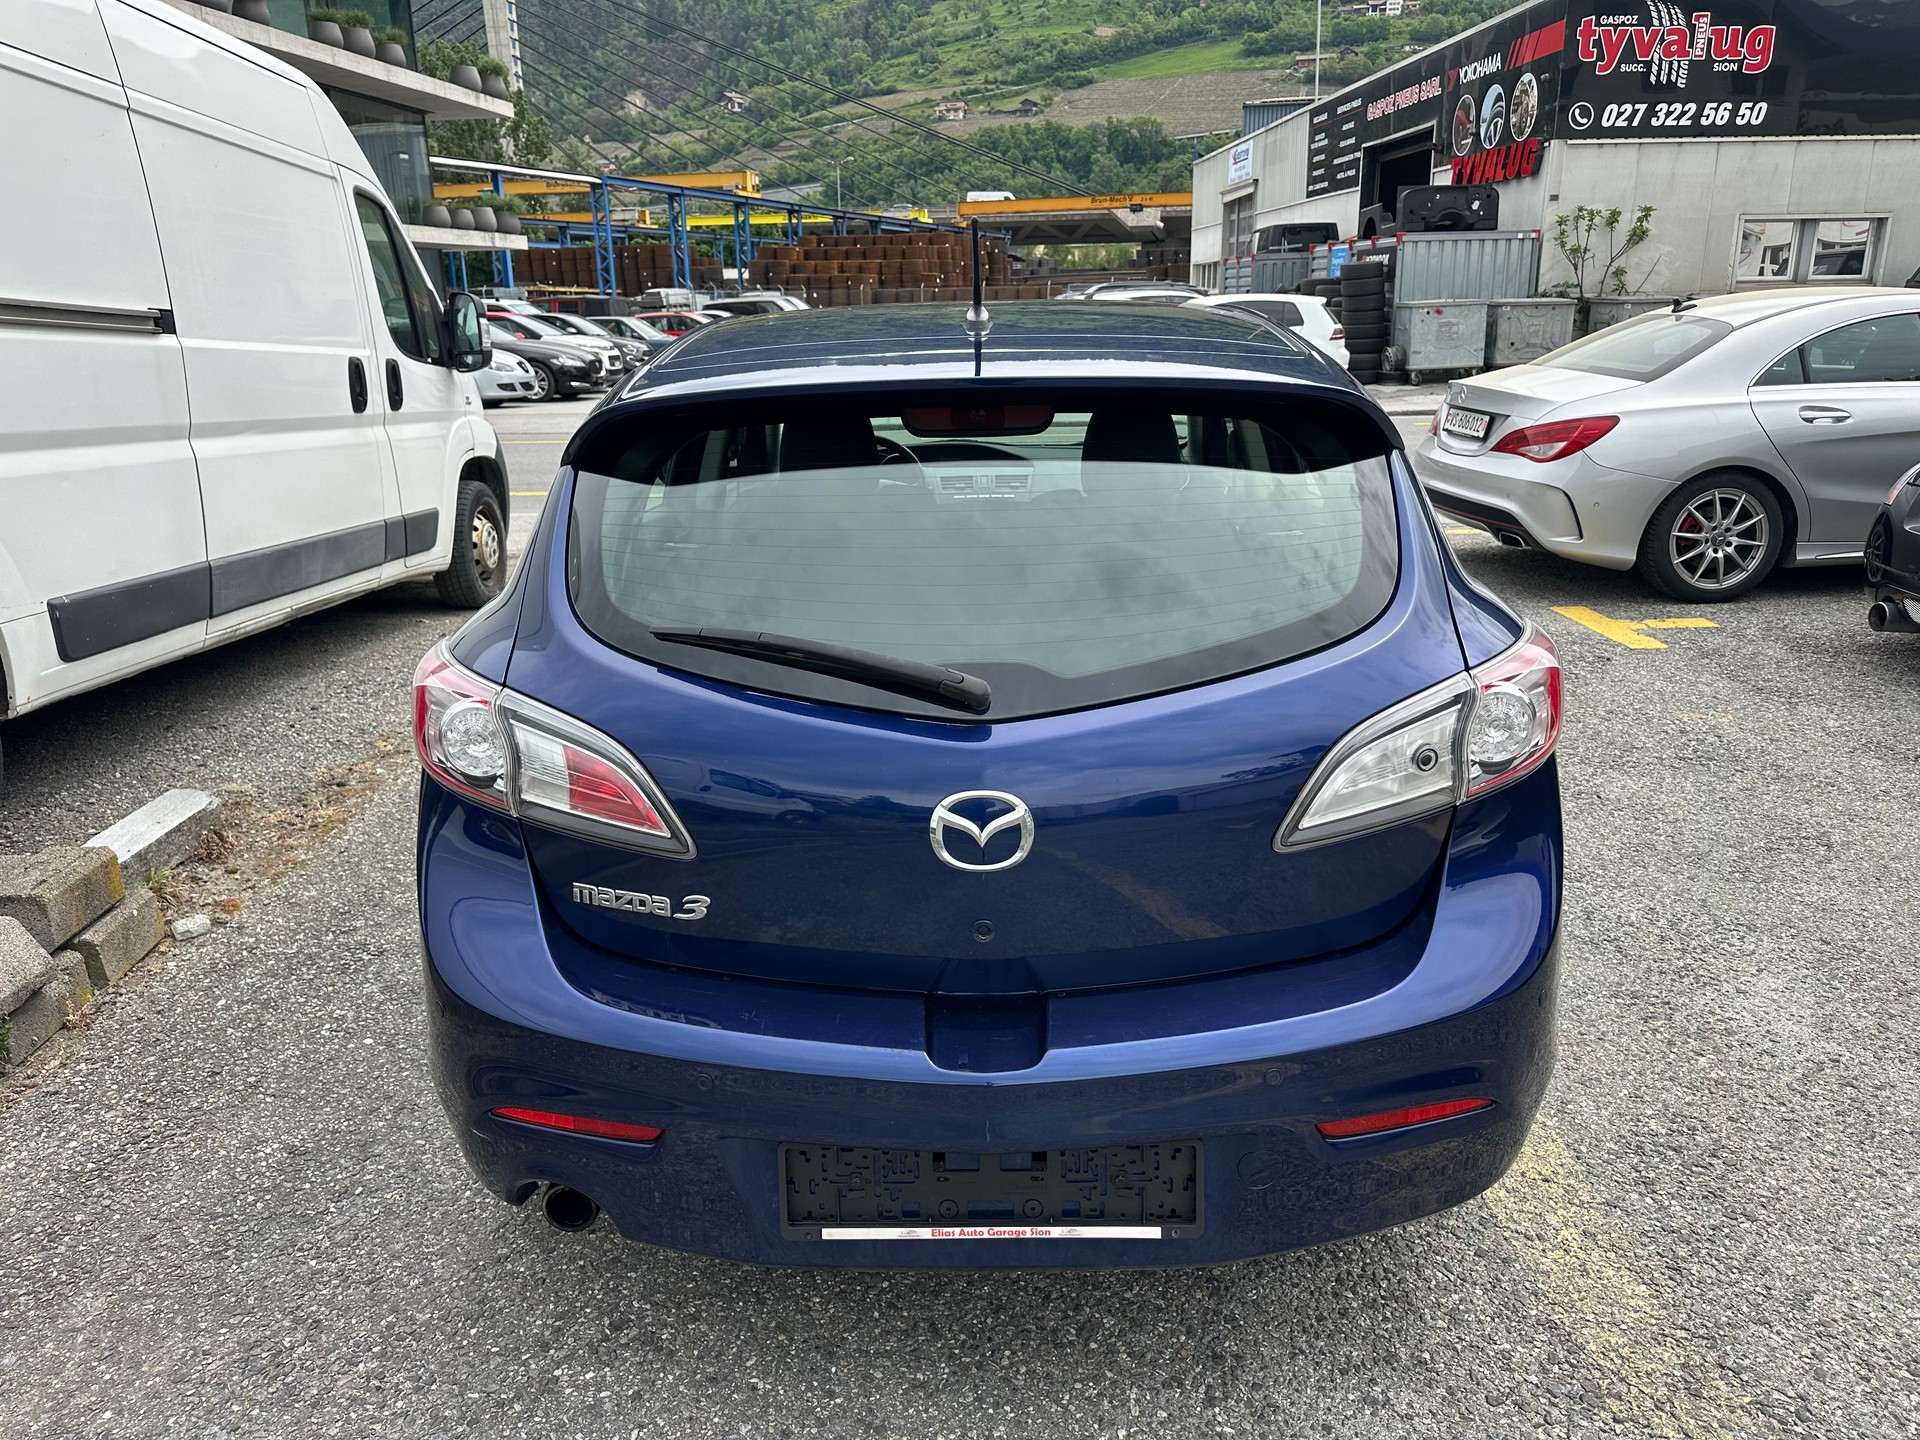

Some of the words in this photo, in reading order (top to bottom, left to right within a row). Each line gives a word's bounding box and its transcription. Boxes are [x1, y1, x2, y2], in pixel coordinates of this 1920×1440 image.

[1600, 15, 1638, 25] GASPOZ
[1695, 17, 1708, 56] PNEUS
[1458, 52, 1502, 85] YOKOHAMA
[1620, 63, 1647, 73] SUCC.
[1713, 62, 1738, 72] SION
[1367, 94, 1395, 121] GASPOZ
[1395, 84, 1419, 111] PNEUS
[1420, 76, 1442, 101] SARL
[1601, 103, 1648, 128] 027
[1651, 102, 1697, 127] 322
[1700, 102, 1732, 126] 56
[1735, 101, 1768, 126] 50
[1451, 137, 1539, 186] TYVALUG
[673, 895, 711, 920] 3
[931, 1228, 955, 1237] Elias
[958, 1228, 984, 1237] Auto
[987, 1228, 1027, 1238] Garage
[1030, 1227, 1051, 1237] Sion
